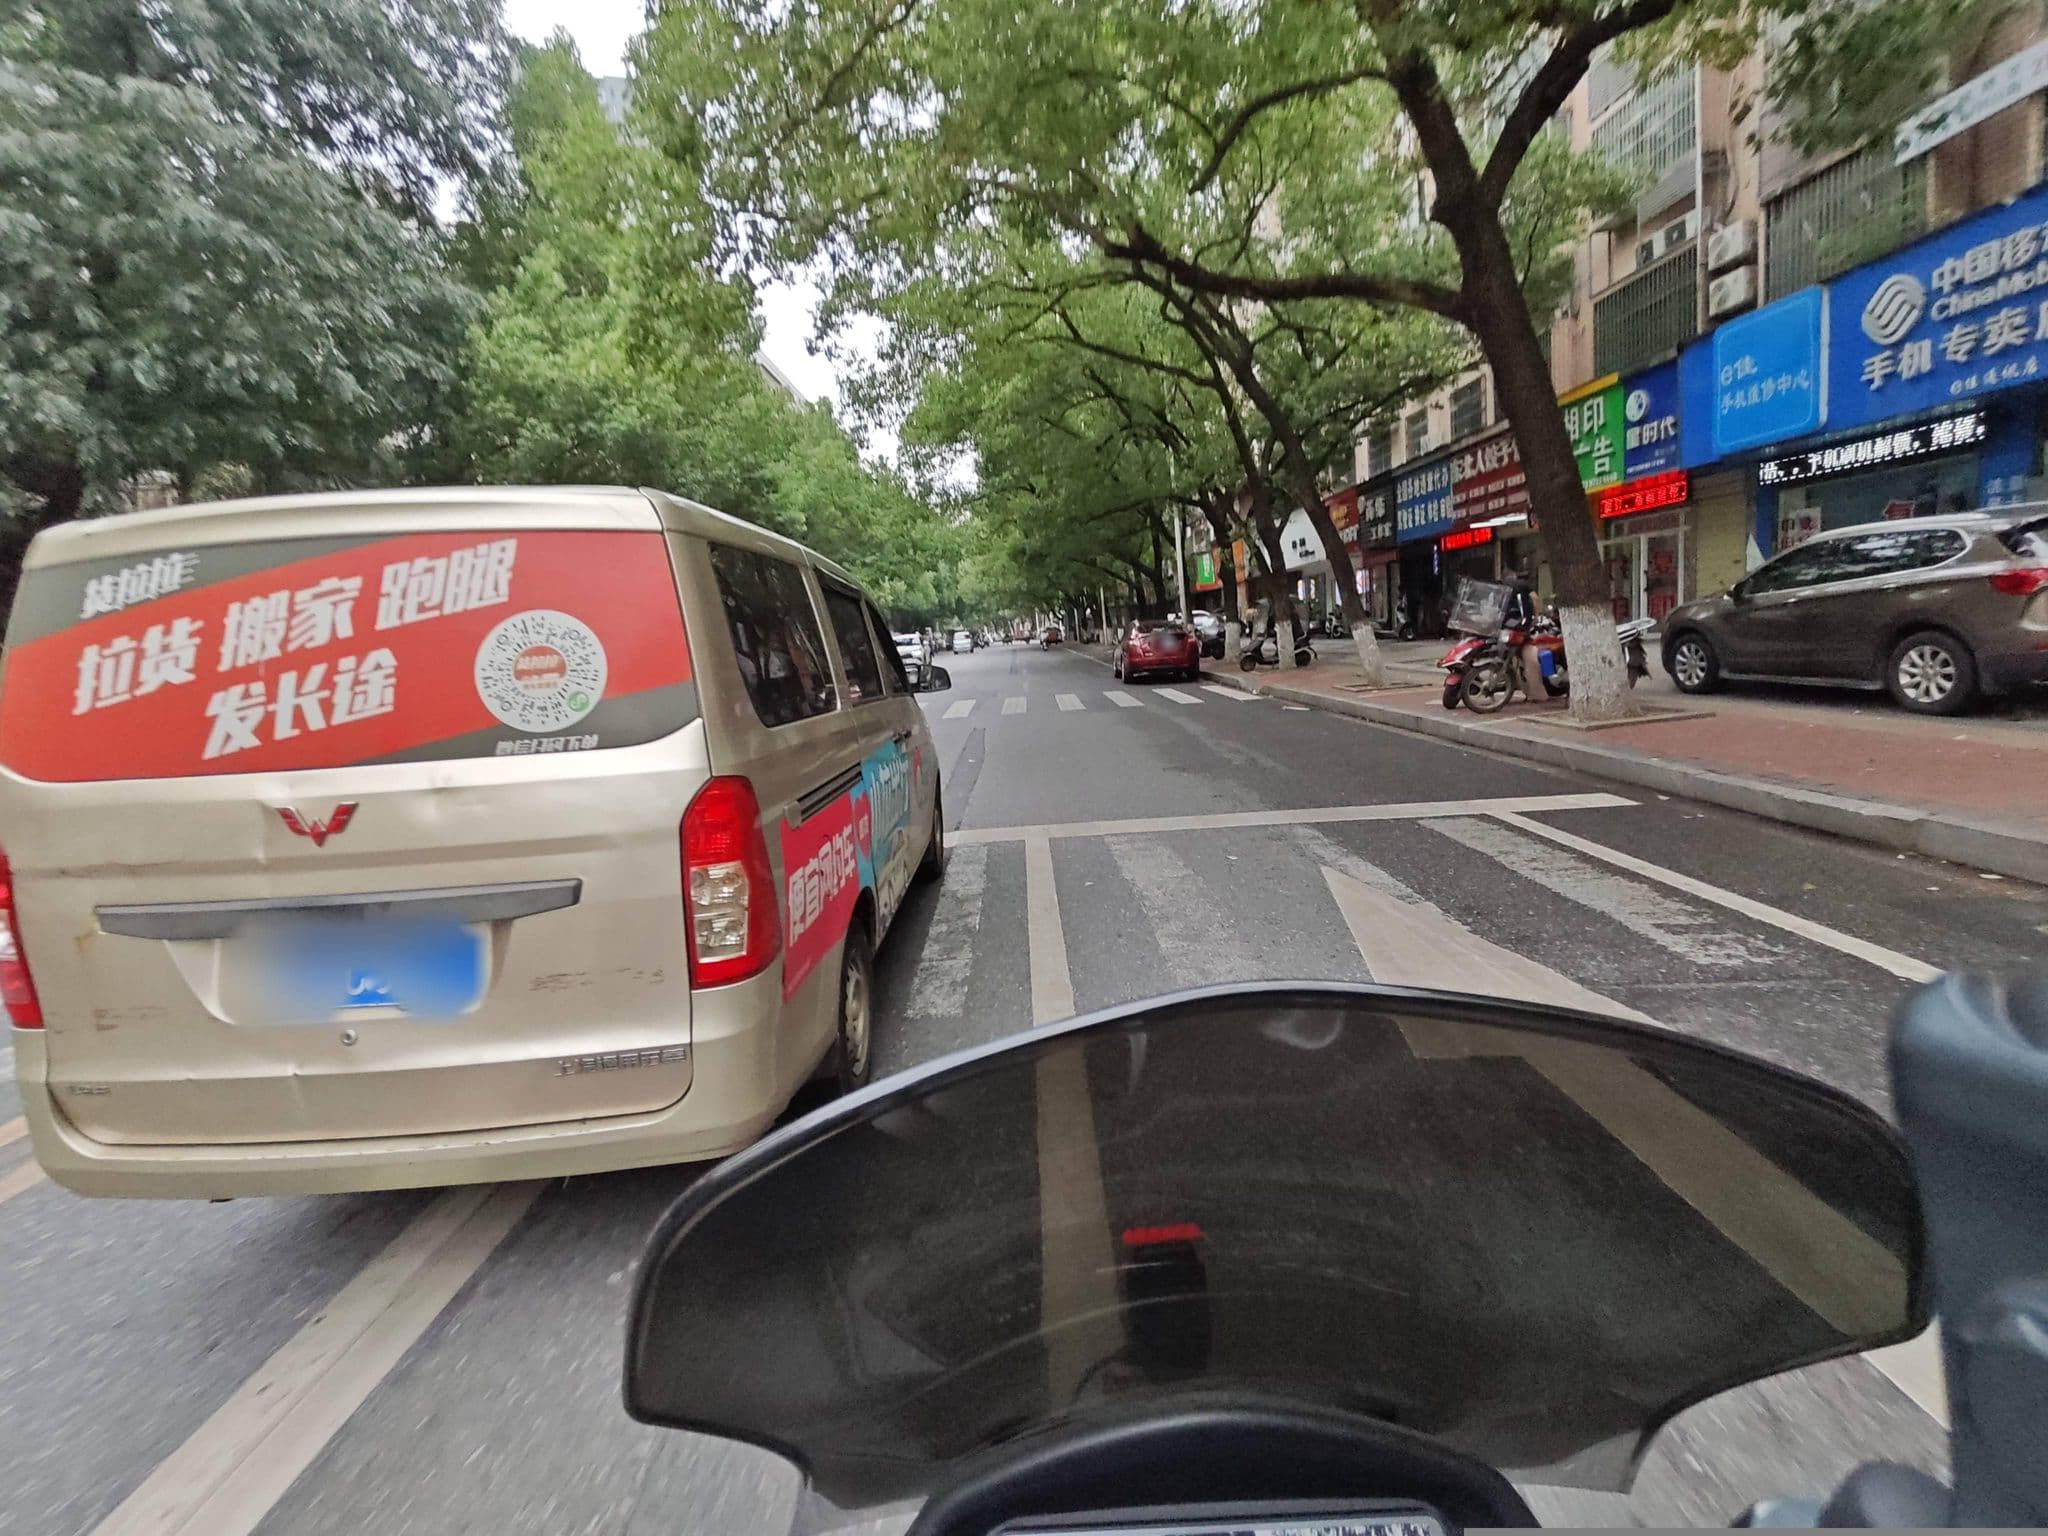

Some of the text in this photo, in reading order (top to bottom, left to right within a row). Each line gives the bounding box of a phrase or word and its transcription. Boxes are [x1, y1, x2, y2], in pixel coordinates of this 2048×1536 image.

[1932, 221, 2048, 295] 中国移
[80, 552, 200, 619] 货拉拉
[73, 539, 518, 715] 拉货 搬家 跑腿
[202, 647, 398, 760] 发长途
[496, 734, 600, 756] 微信扫码下单
